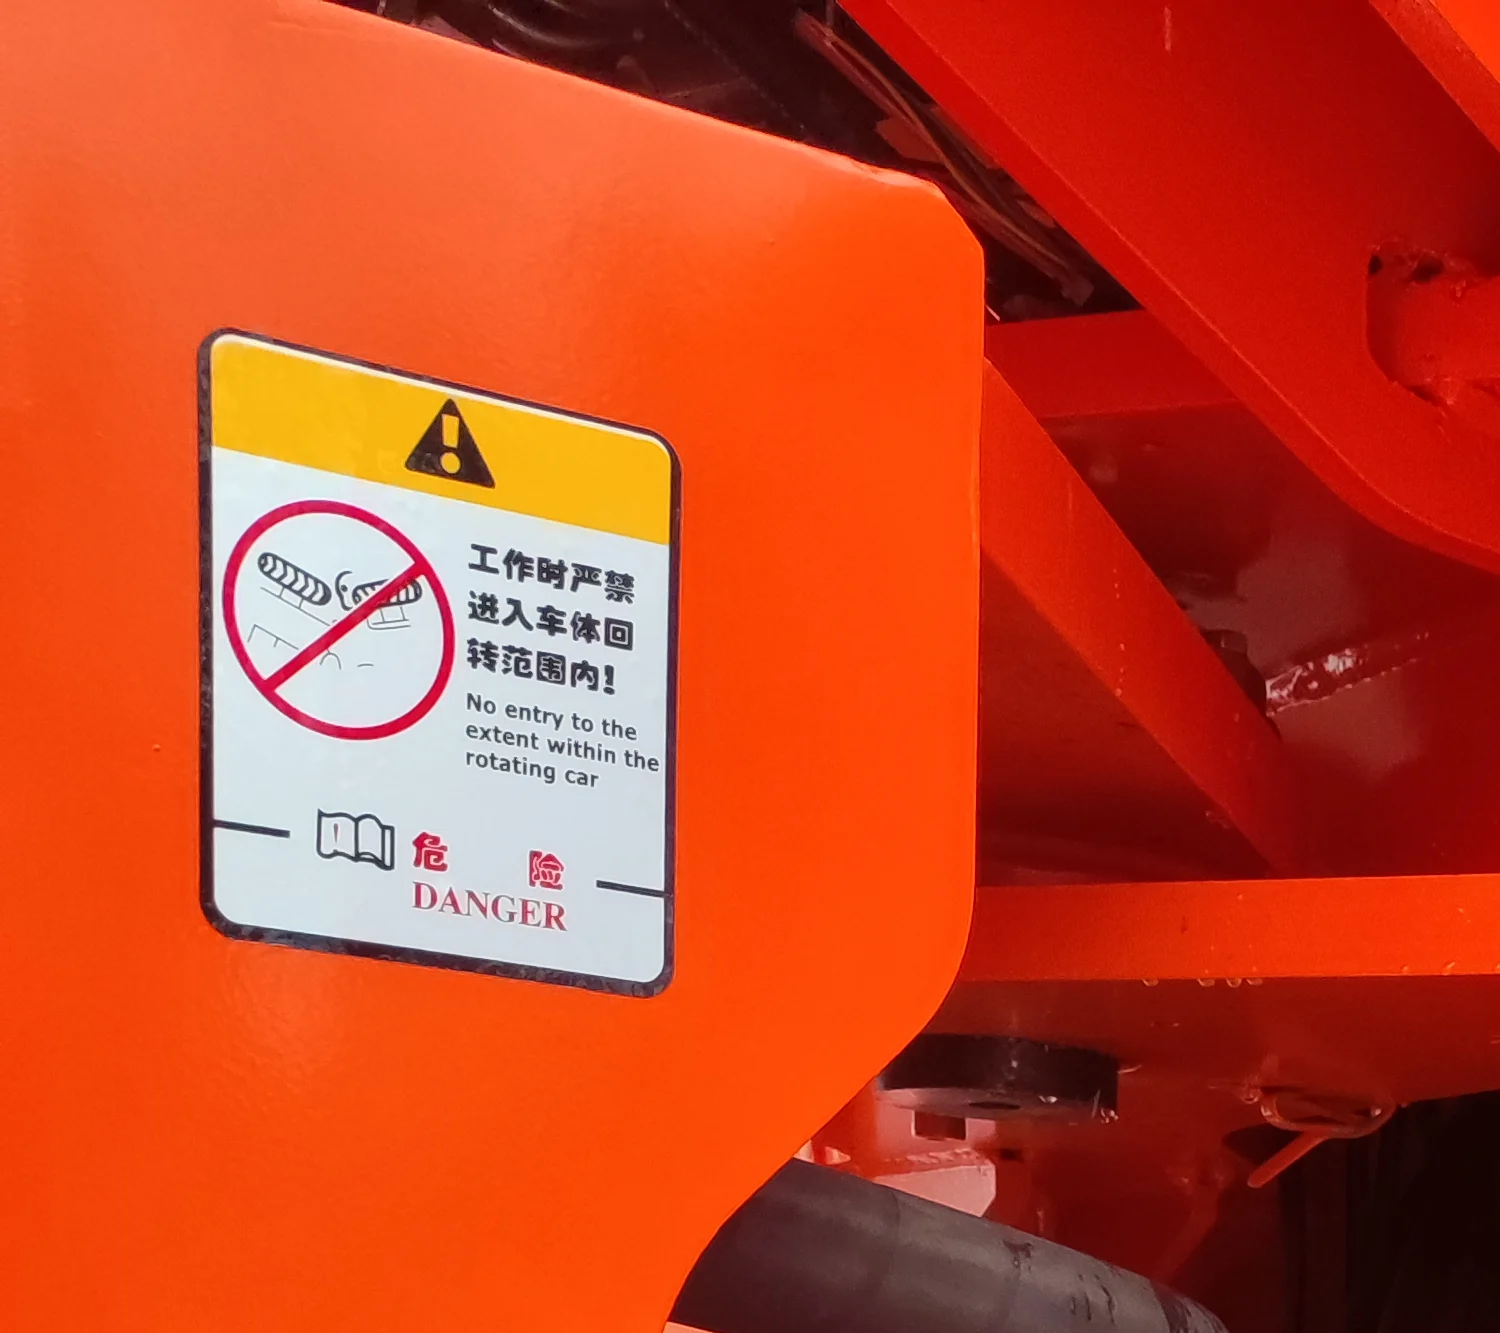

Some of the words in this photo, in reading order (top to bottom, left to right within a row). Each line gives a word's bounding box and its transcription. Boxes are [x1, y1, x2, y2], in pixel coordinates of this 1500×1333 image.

[468, 543, 635, 604] 工作时严禁
[467, 590, 634, 651] 进入车体回
[466, 692, 496, 715] No
[504, 703, 564, 731] entry
[571, 713, 594, 733] to
[601, 718, 637, 741] the
[465, 724, 539, 750] extent
[547, 738, 616, 764] within
[623, 749, 660, 772] the
[466, 751, 556, 784] rotating
[565, 769, 600, 788] car
[412, 831, 448, 872] 危
[528, 849, 565, 891] 险
[411, 880, 568, 932] DANGER
